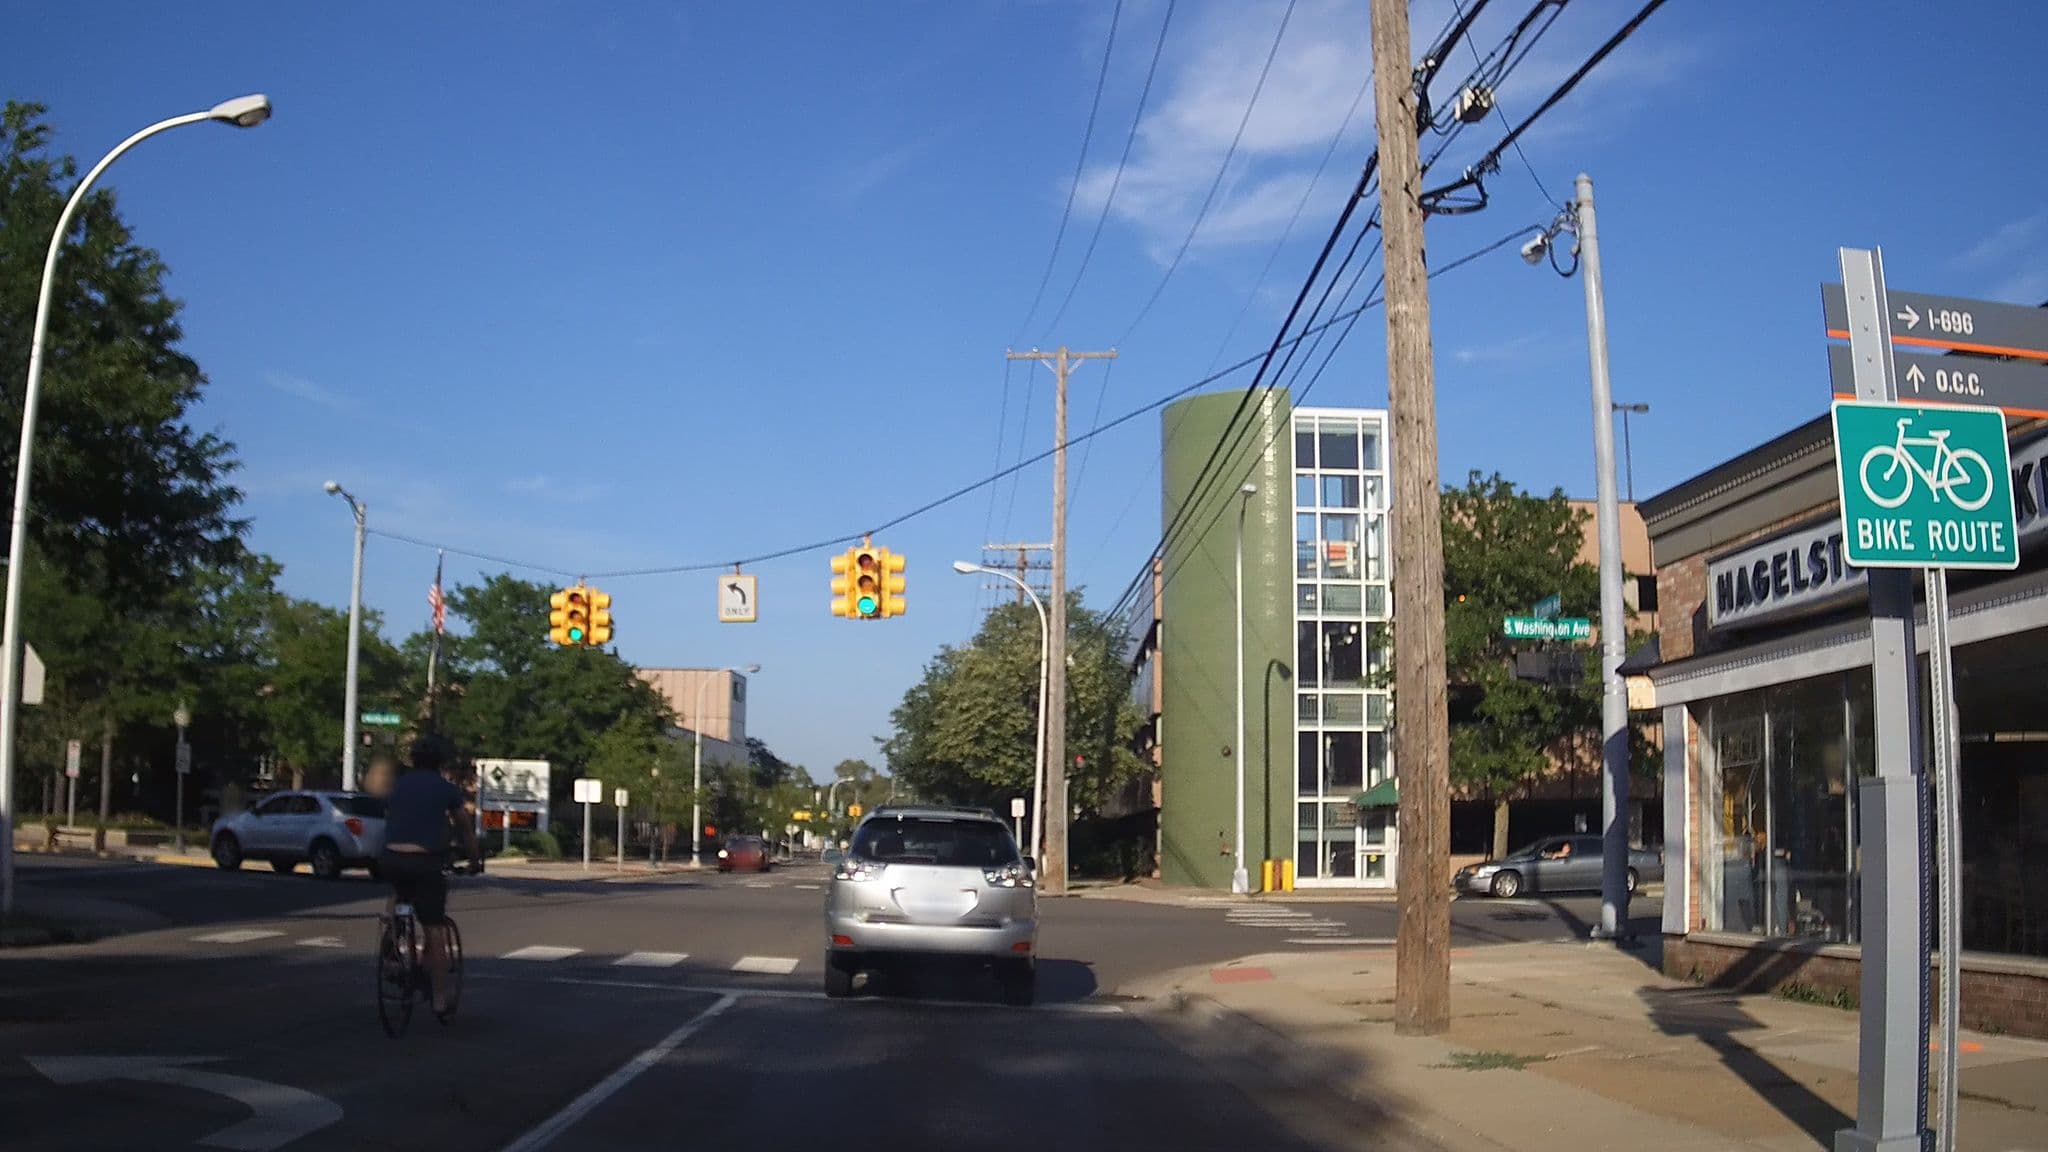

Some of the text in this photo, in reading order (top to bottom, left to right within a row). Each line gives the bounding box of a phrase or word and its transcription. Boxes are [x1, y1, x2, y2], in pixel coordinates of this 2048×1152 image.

[1927, 307, 1974, 335] I-696
[1935, 368, 1985, 397] O.C.C.
[1857, 517, 2006, 553] BIKE ROUTE
[1716, 533, 1861, 615] HAGELST
[1572, 620, 1590, 637] Ave
